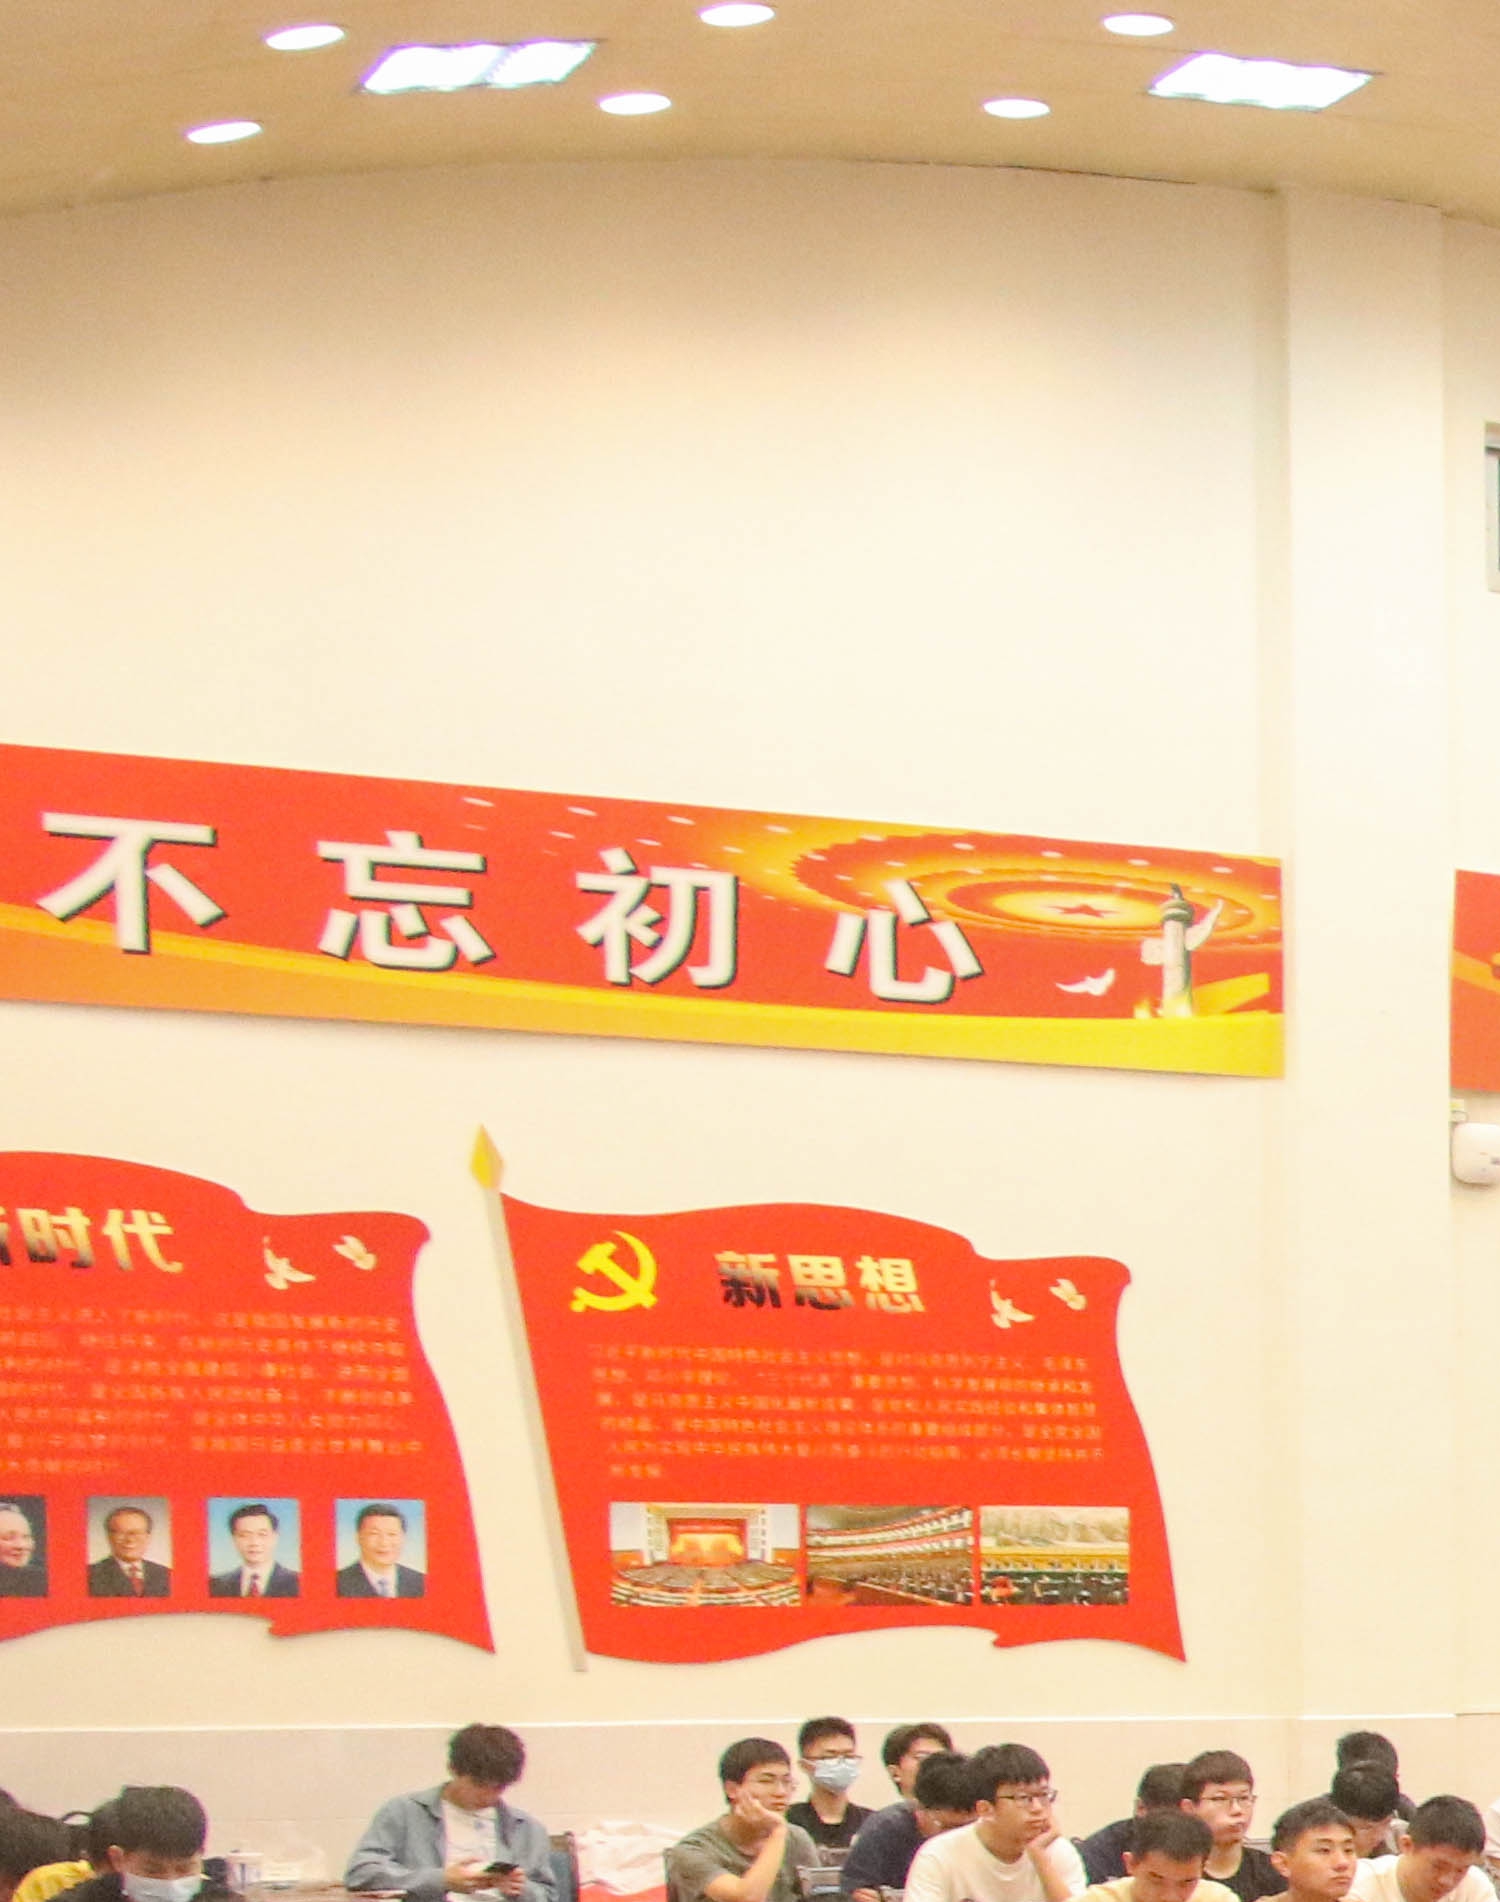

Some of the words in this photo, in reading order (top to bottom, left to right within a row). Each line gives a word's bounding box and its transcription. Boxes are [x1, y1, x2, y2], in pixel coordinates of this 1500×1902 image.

[38, 810, 985, 1006] 不忘初心
[714, 1250, 924, 1314] 新思想
